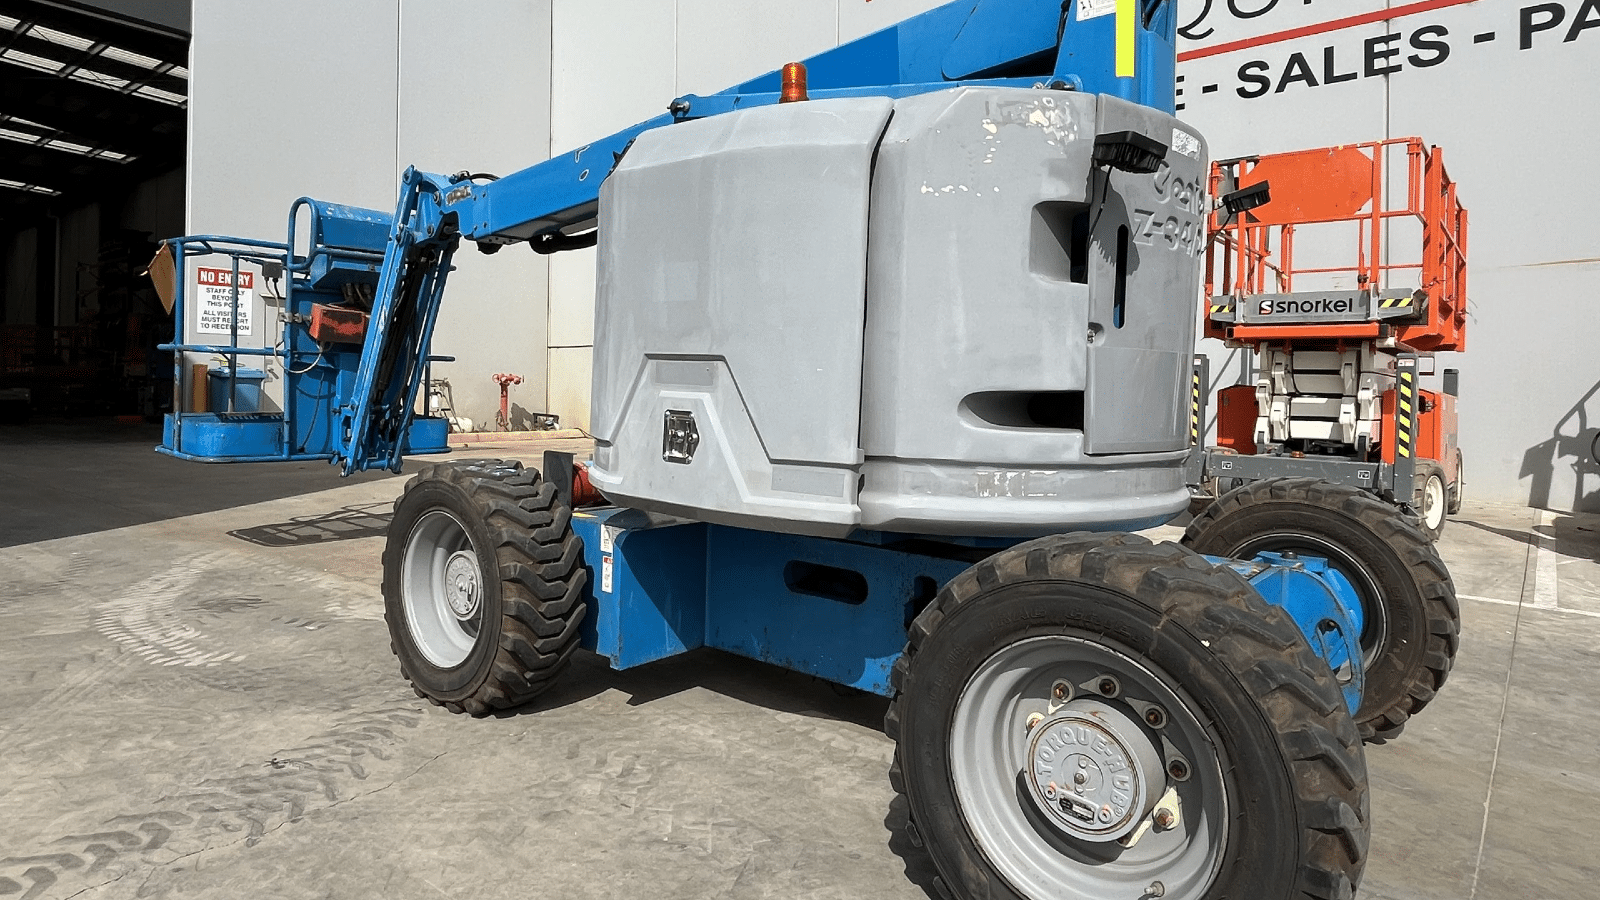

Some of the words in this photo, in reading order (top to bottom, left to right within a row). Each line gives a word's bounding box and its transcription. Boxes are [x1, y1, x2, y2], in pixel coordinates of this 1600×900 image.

[1235, 24, 1451, 100] SALES
[201, 271, 215, 283] NO
[218, 273, 250, 286] ENRY
[1276, 298, 1353, 314] snorkel
